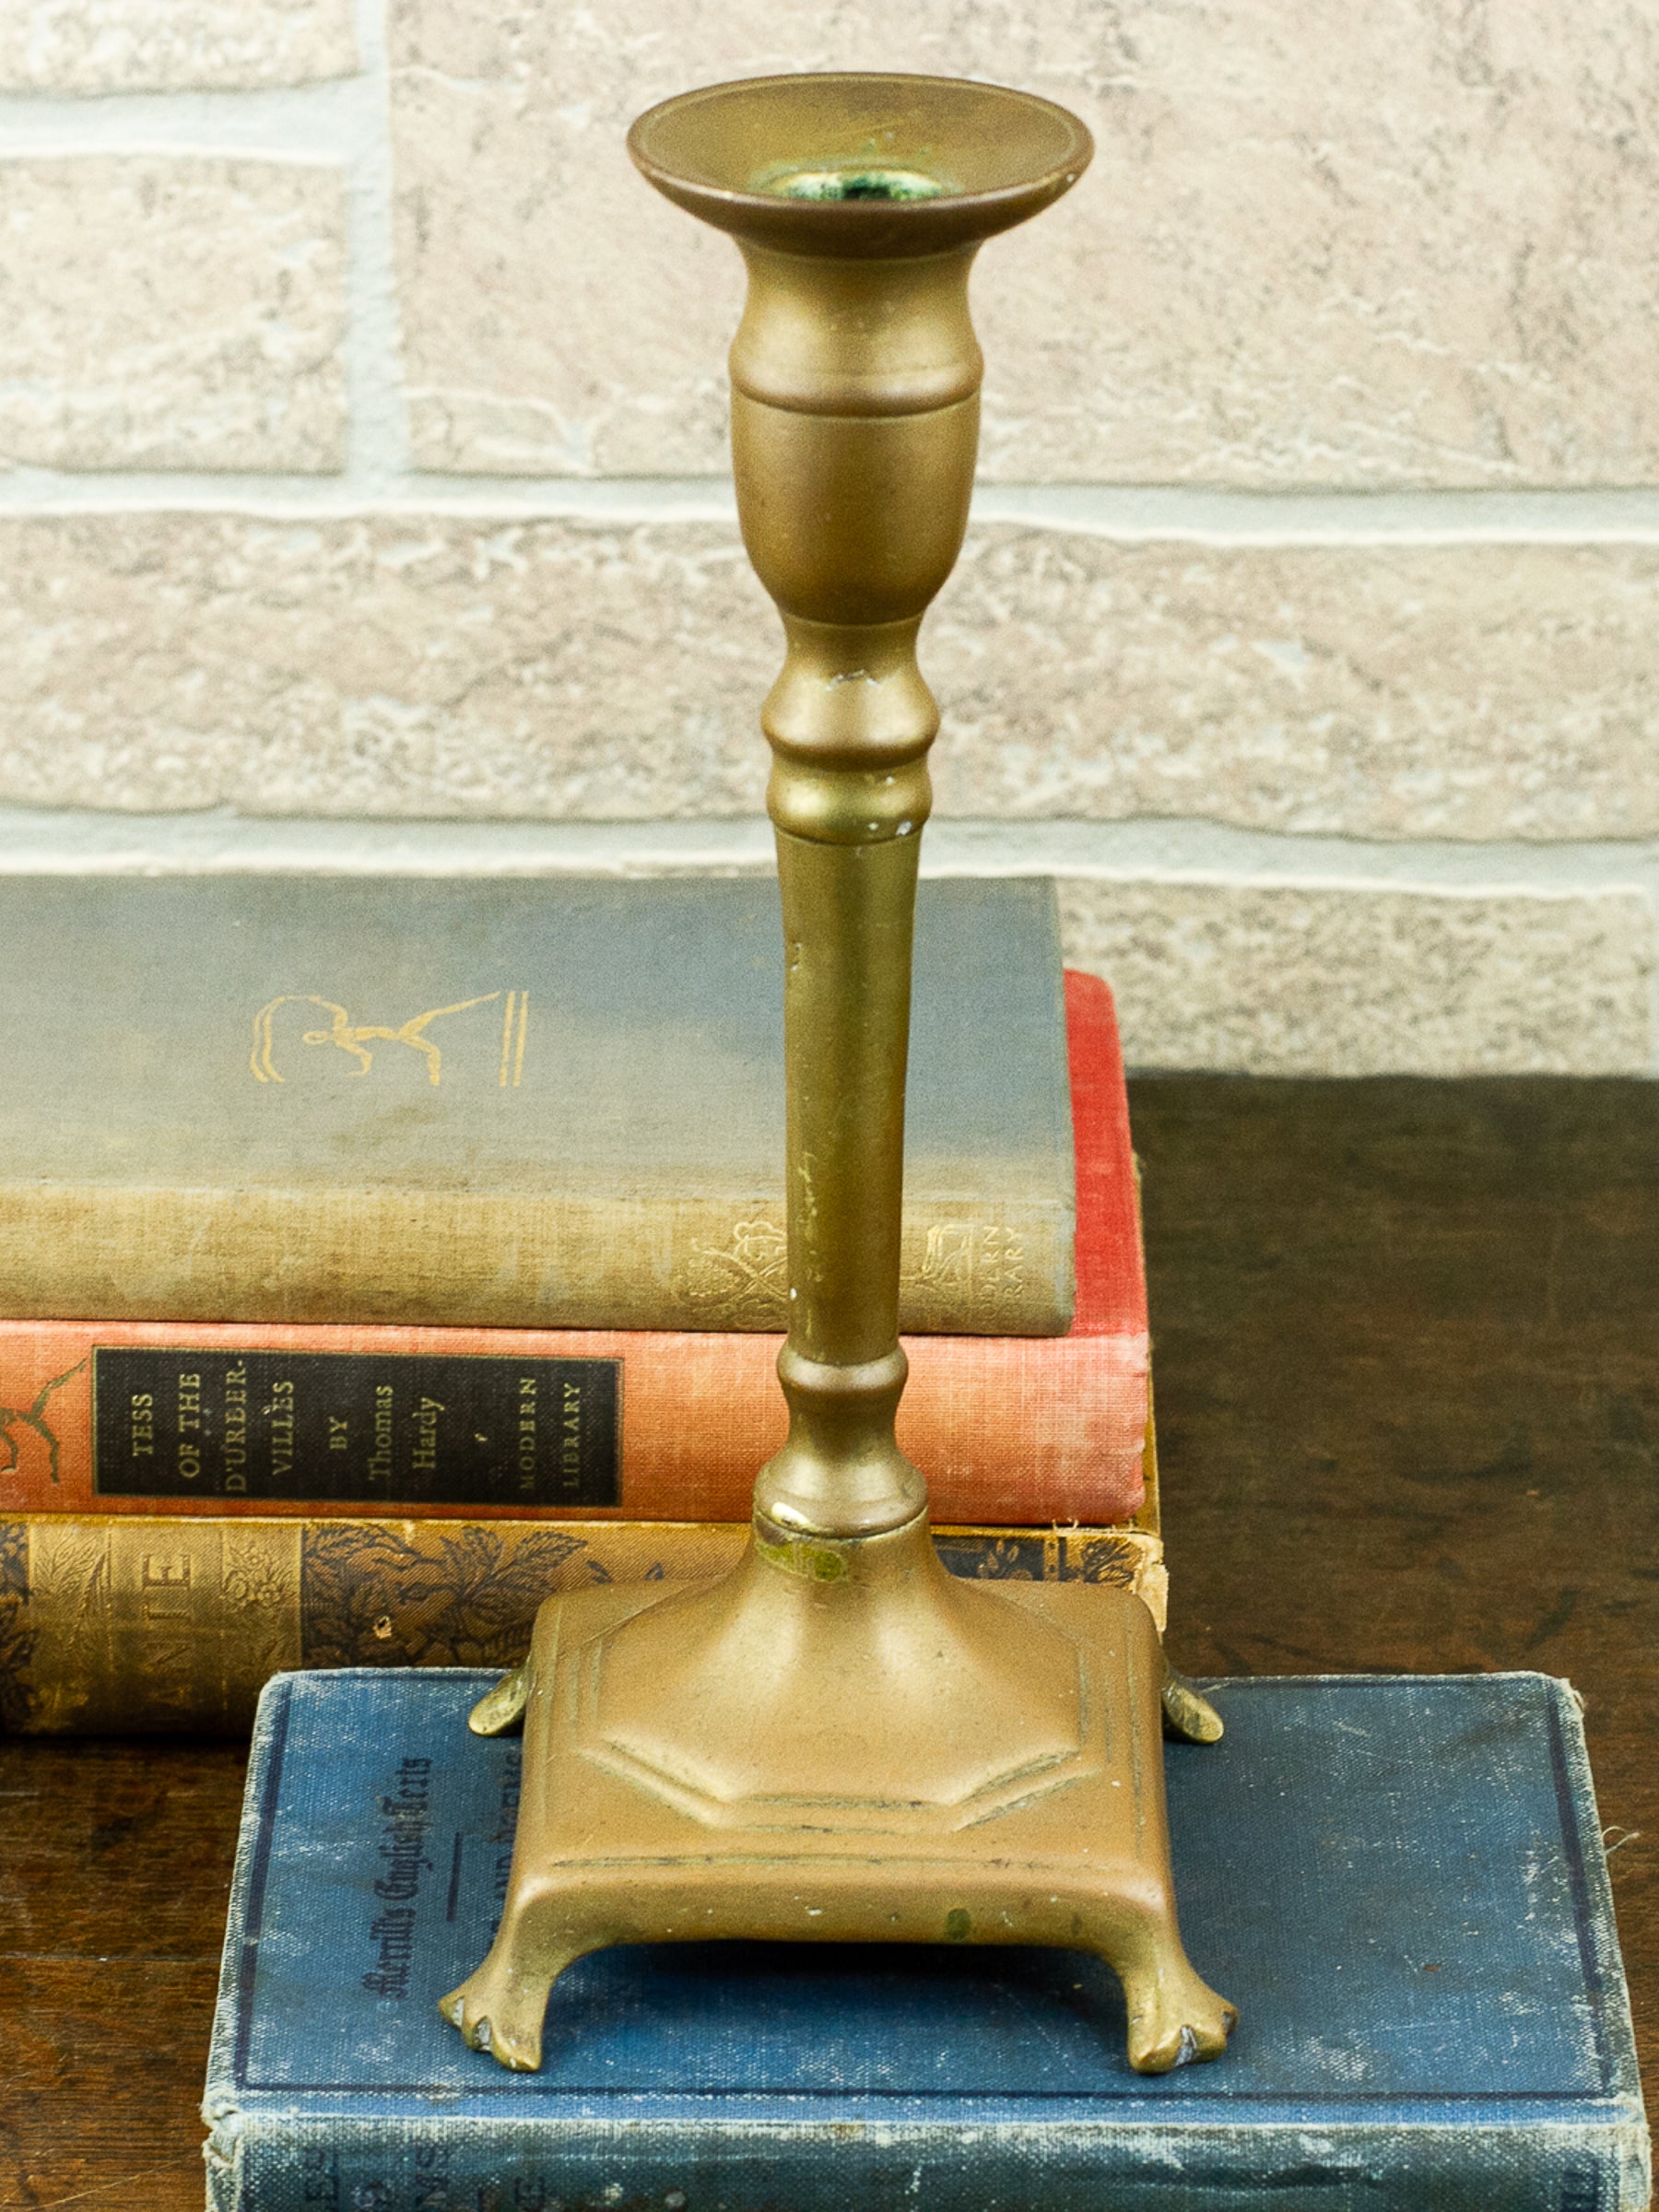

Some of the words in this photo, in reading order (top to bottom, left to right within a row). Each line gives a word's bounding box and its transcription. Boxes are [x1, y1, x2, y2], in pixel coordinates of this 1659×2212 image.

[132, 1394, 154, 1456] TESS
[178, 1373, 201, 1432] THE
[272, 1381, 294, 1476] VILLES
[328, 1416, 348, 1450] BY
[369, 1384, 394, 1480] Thomas
[412, 1396, 445, 1469] Hardy
[519, 1377, 536, 1489] MODERN
[562, 1382, 581, 1487] LIBRARY
[178, 1444, 201, 1478] OF
[383, 1758, 432, 1816] Texts
[374, 1819, 432, 1900] English
